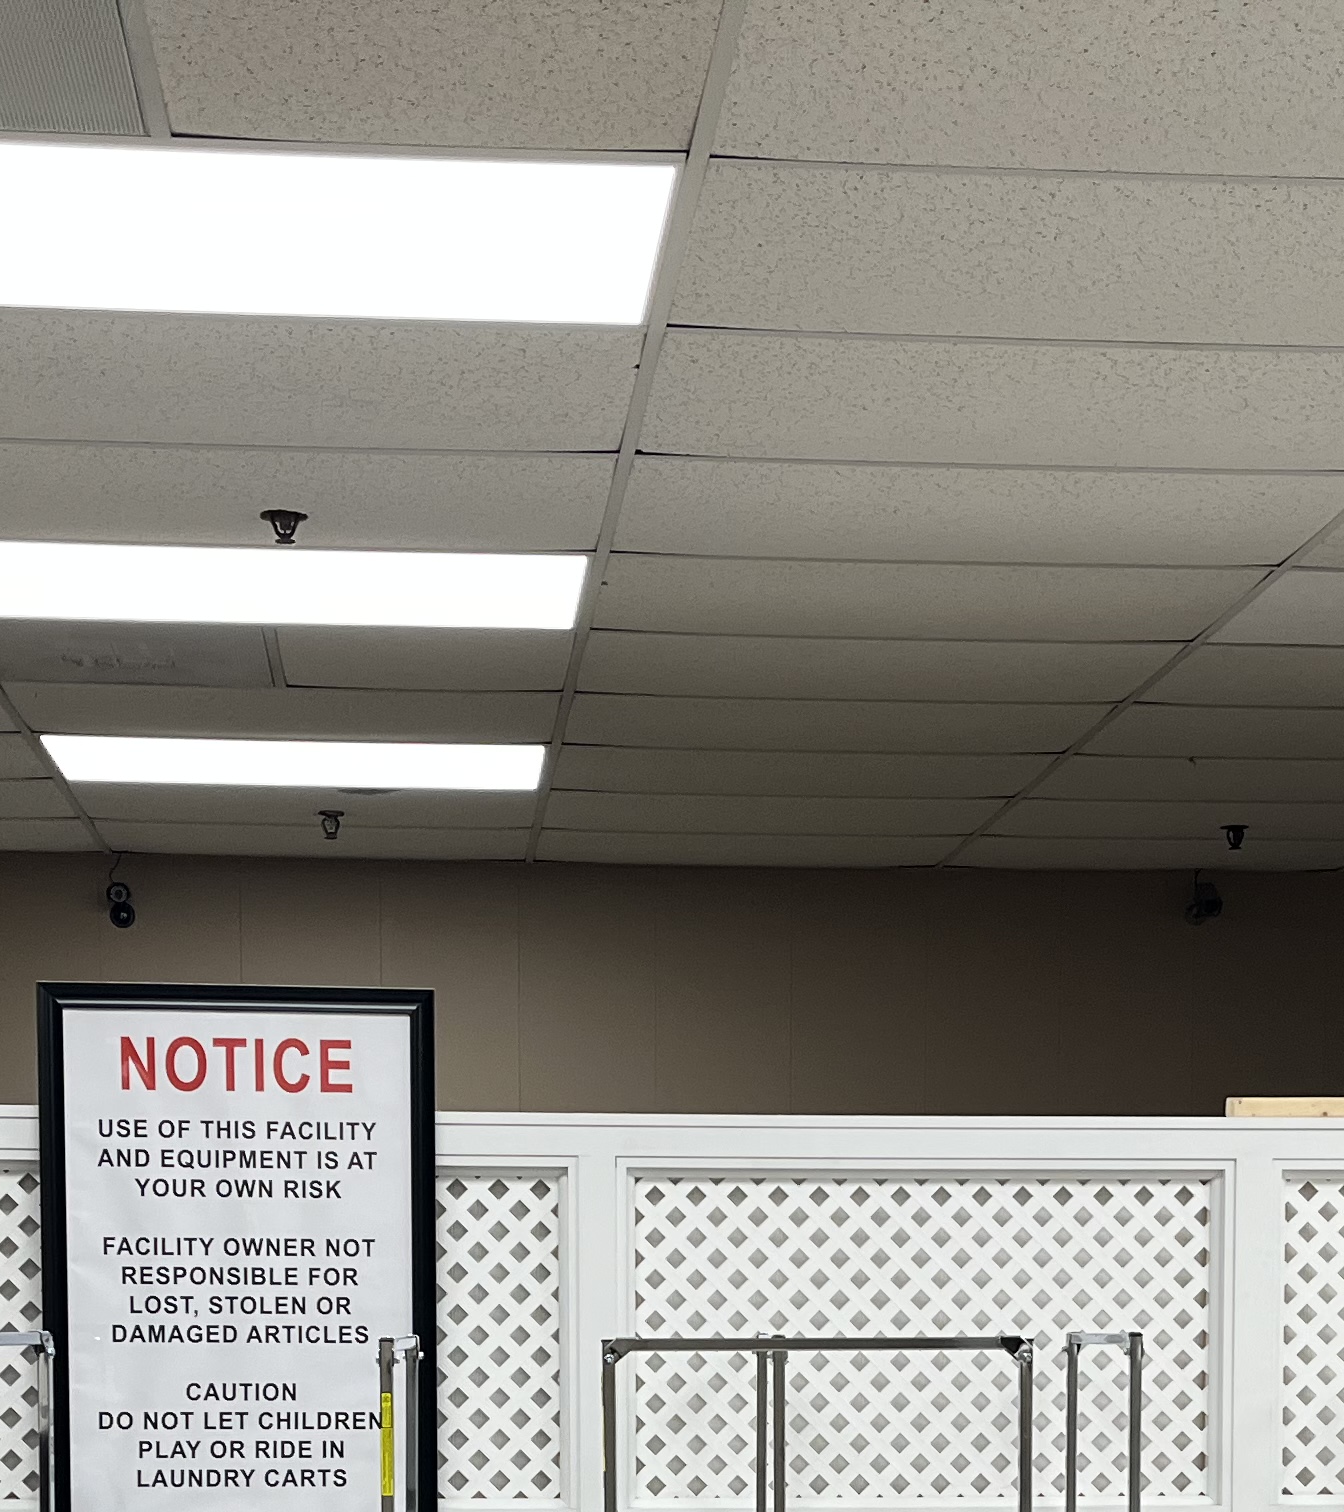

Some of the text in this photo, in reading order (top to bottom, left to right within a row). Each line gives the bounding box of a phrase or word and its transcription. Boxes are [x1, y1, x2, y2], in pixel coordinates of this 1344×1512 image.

[120, 1036, 353, 1094] NOTICE
[98, 1118, 377, 1141] USE OF THIS FACILITY
[97, 1148, 378, 1170] AND EQUIPMENT IS AT
[134, 1177, 342, 1199] YOUR OWN RISK
[103, 1236, 376, 1258] FACILITY OWNER NOT
[121, 1265, 359, 1287] RESPONSIBLE FOR
[129, 1295, 352, 1318] LOST, STOLEN OR
[111, 1324, 369, 1344] DAMAGED ARTICLES
[186, 1382, 297, 1402] CAUTION
[98, 1411, 134, 1431] DO
[143, 1411, 195, 1431] NOT
[203, 1411, 249, 1430] LET
[138, 1439, 345, 1459] PLAY OR RIDE IN
[136, 1468, 347, 1488] LAUNDRY CARTS
